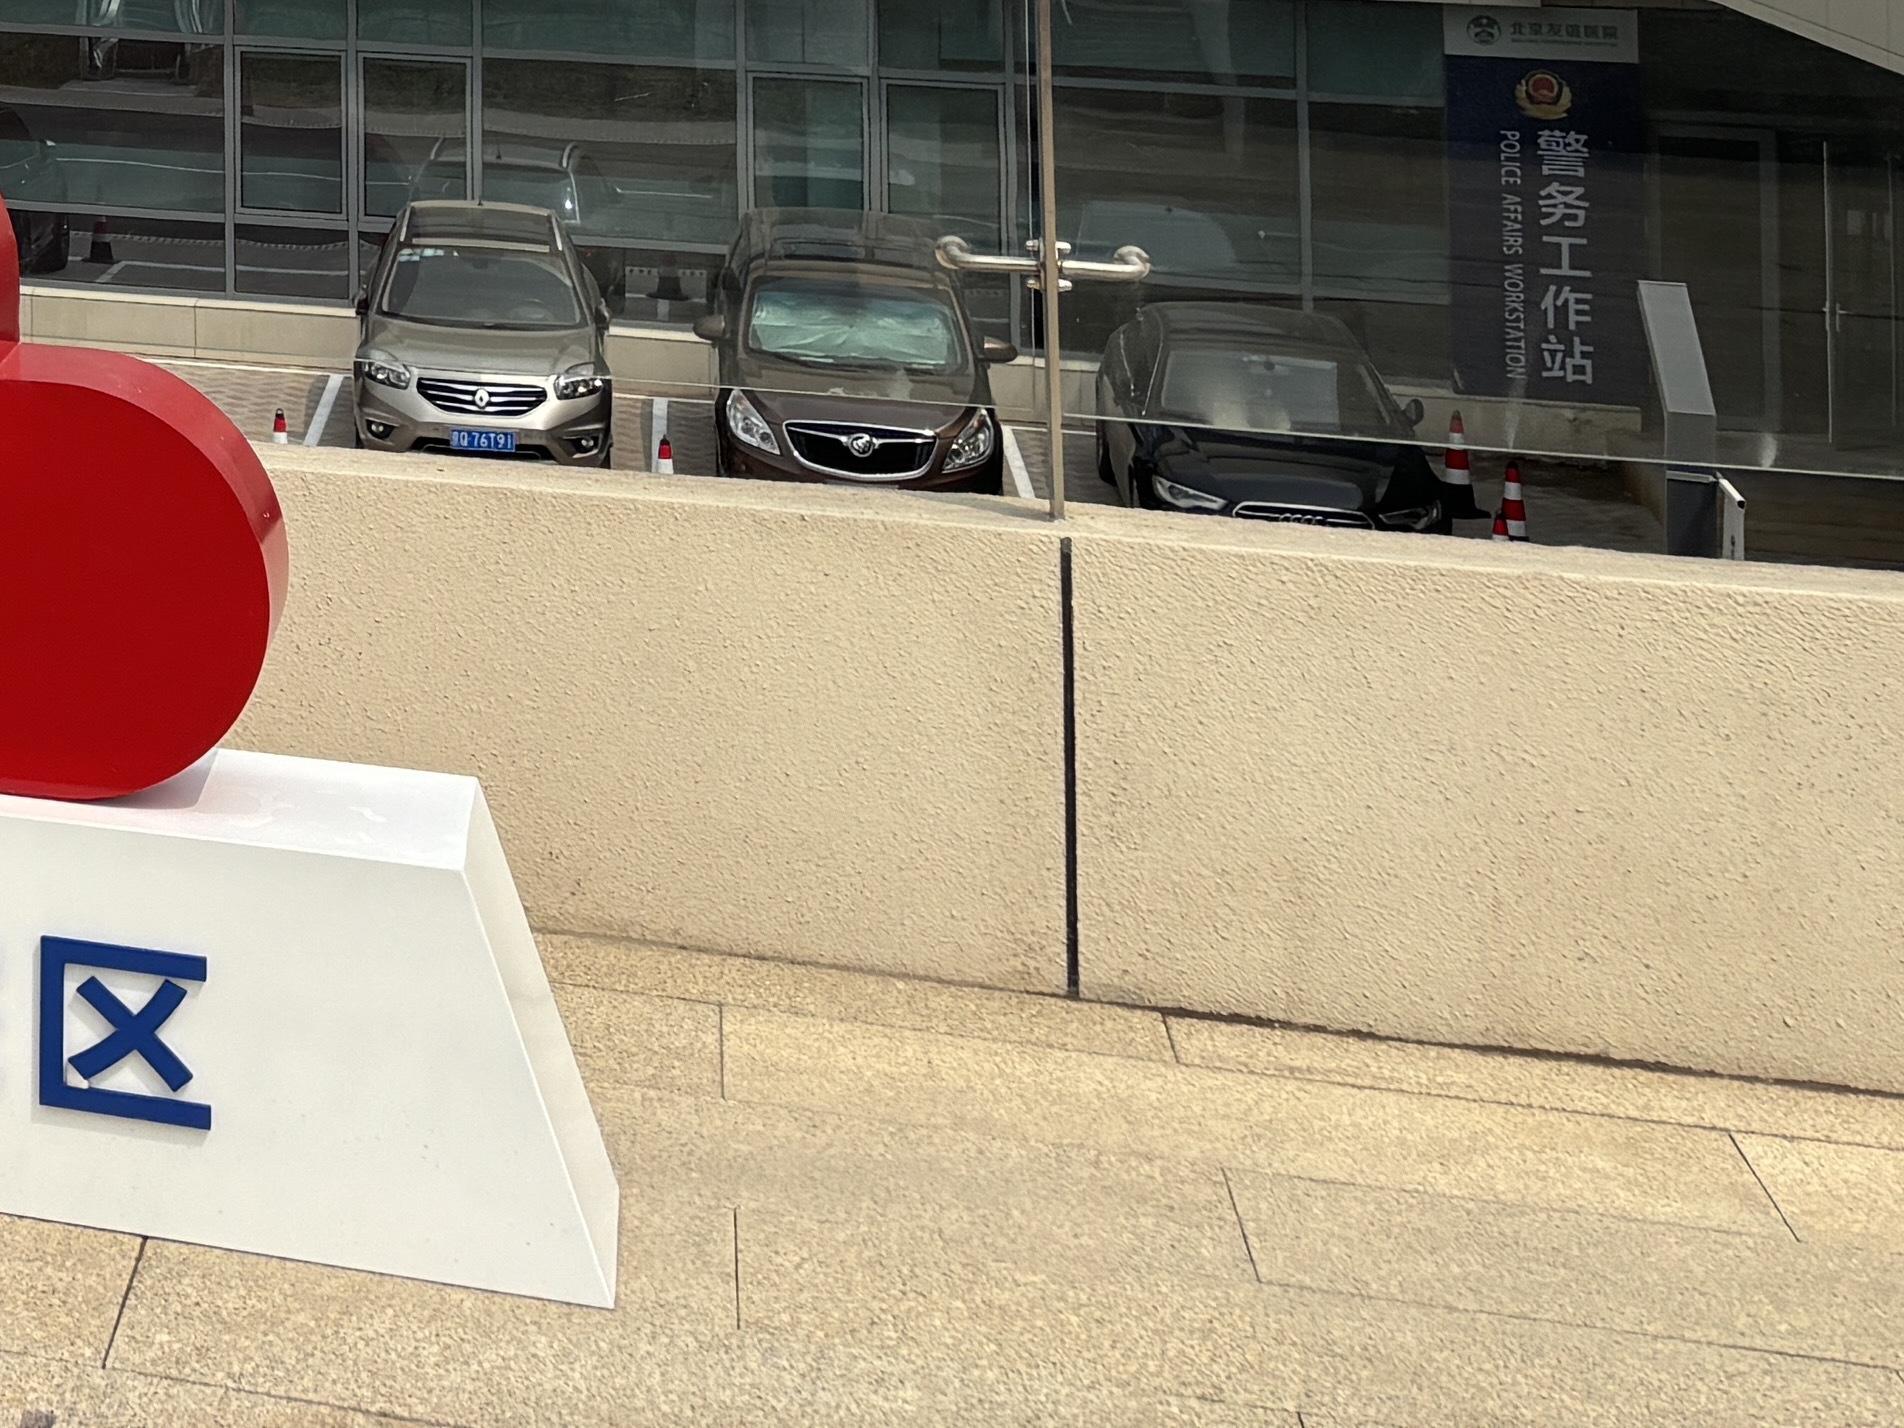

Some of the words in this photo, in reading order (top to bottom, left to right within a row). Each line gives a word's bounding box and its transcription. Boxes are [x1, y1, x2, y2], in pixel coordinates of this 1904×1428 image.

[1499, 129, 1520, 186] POLICE
[1501, 193, 1523, 256] AFFAIRS
[1536, 128, 1594, 386] 警务工作站
[1504, 263, 1527, 380] WORKSTATION
